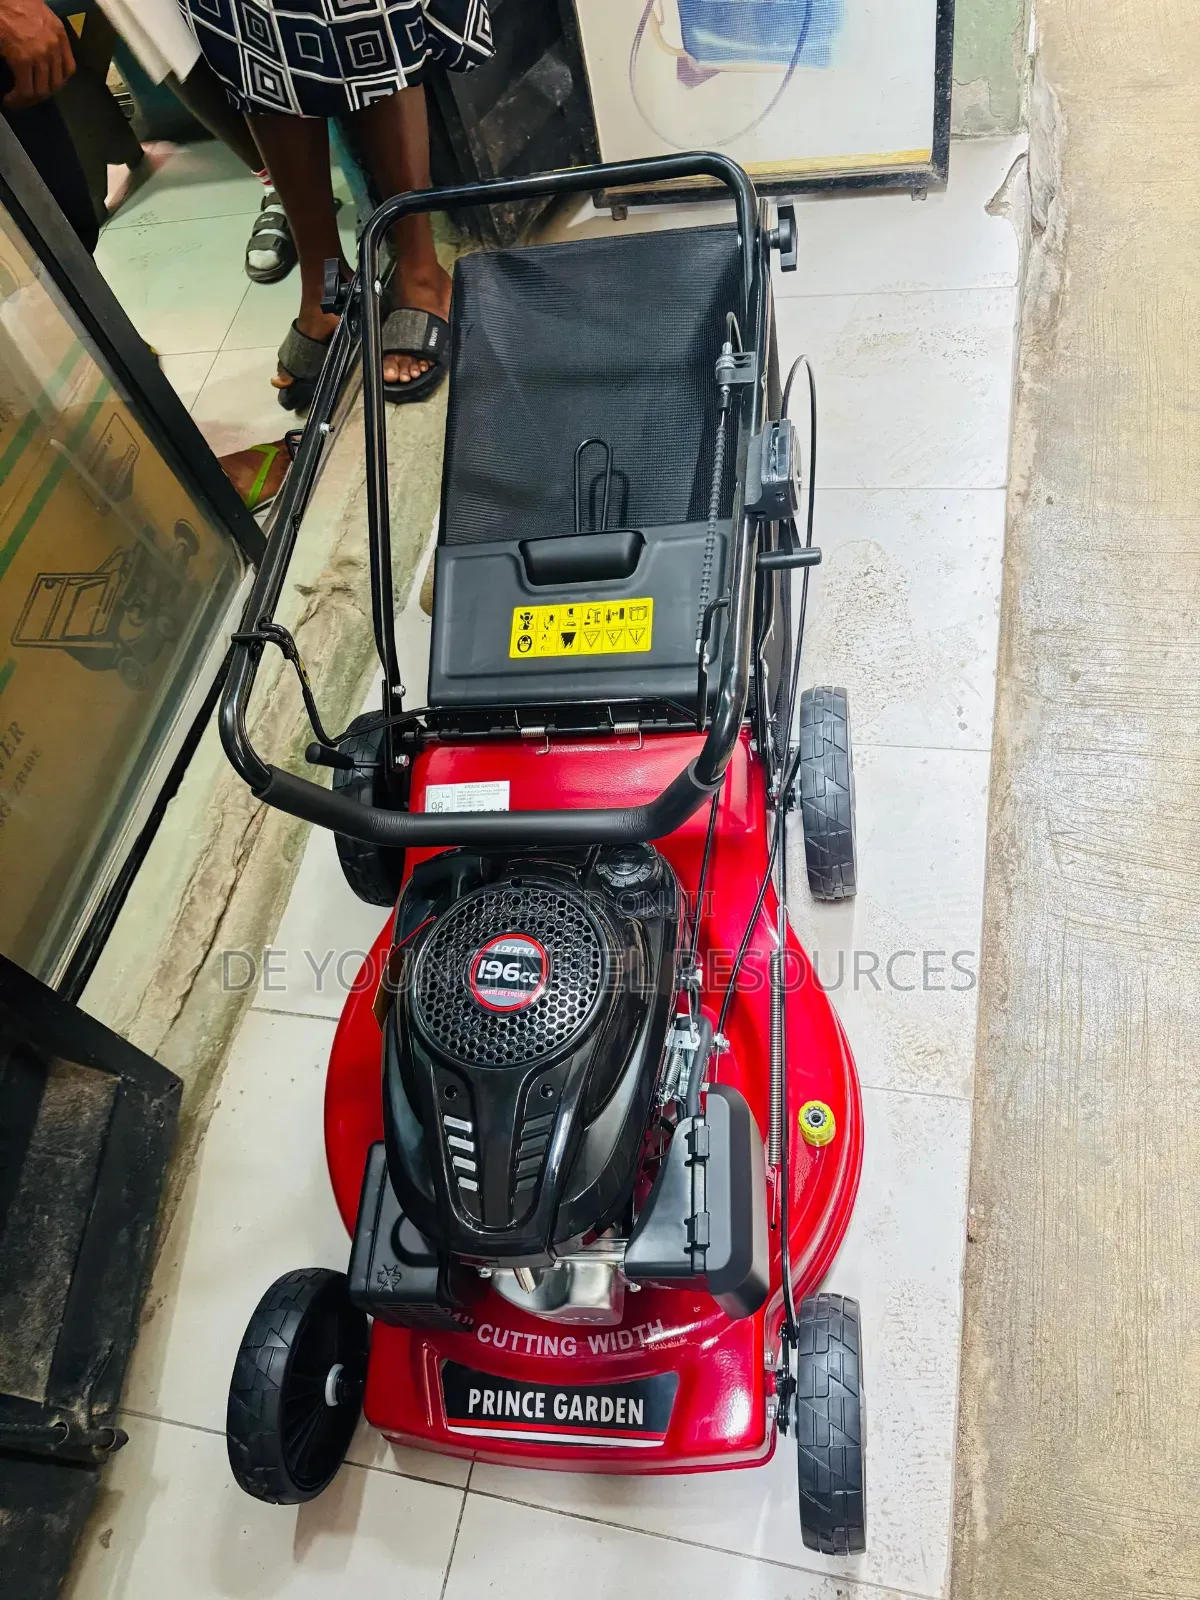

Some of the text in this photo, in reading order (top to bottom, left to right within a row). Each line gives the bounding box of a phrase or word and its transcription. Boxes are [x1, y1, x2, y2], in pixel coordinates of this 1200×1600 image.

[477, 959, 540, 984] 196cc
[477, 1323, 577, 1356] CUTTING
[587, 1318, 665, 1355] WIDTH
[467, 1388, 644, 1425] PRINCE GARDEN
